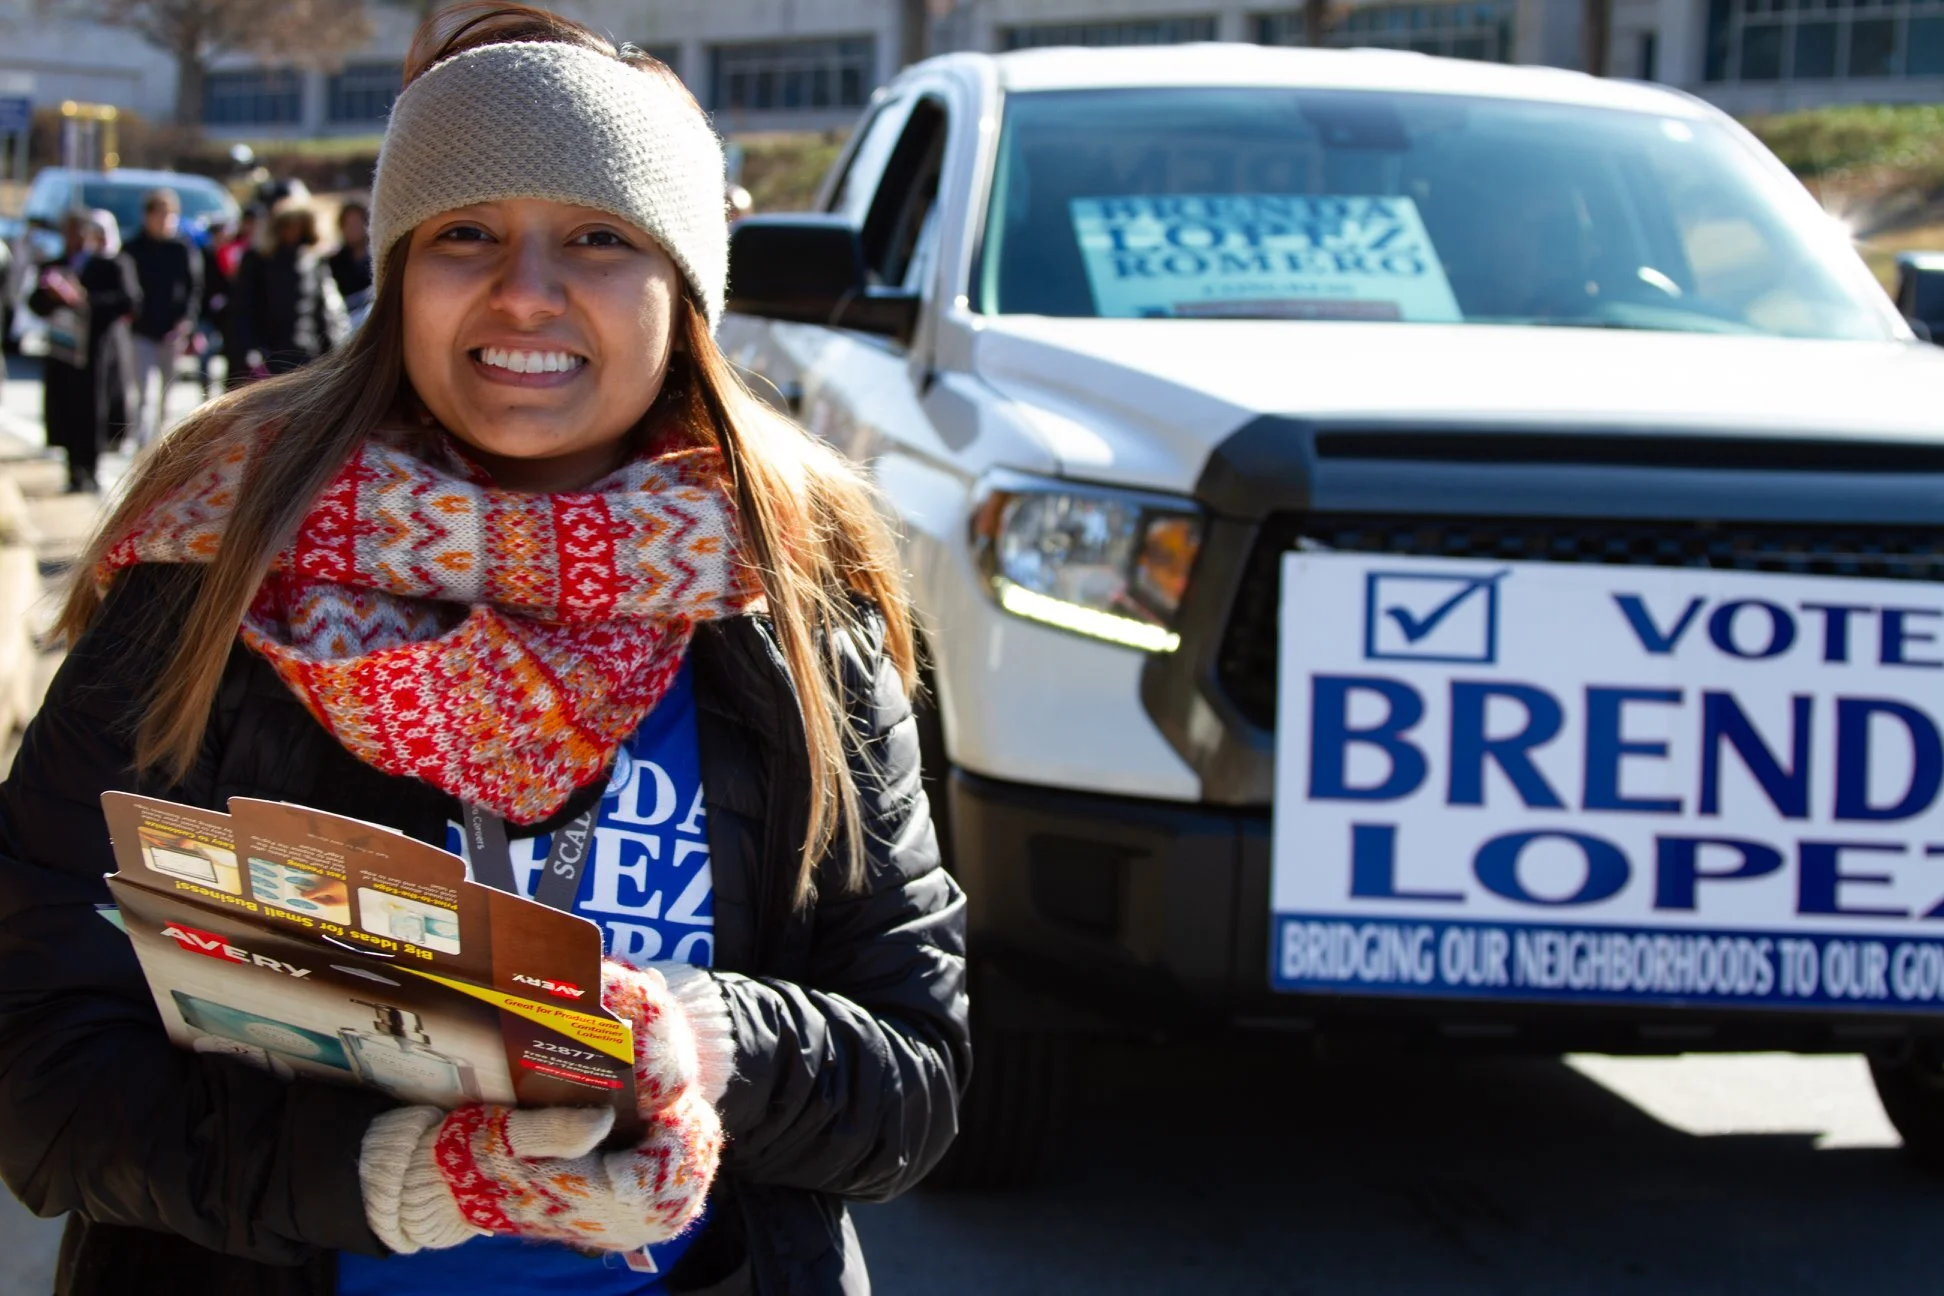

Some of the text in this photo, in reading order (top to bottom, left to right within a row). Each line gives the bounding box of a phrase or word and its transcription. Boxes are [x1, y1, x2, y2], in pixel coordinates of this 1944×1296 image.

[1108, 250, 1427, 279] ROMERO
[1609, 592, 1944, 668] VOTE
[1306, 673, 1944, 823] BREND
[175, 881, 434, 961] Big Ideas for Small Business!
[160, 927, 312, 979] AVERY
[1279, 920, 1435, 985] BRIDGING
[1439, 925, 1510, 988] OUR
[1513, 928, 1775, 996] NEIGHBORHOODS
[1777, 937, 1820, 998] TO
[1821, 939, 1889, 1000] OUR
[512, 974, 586, 997] AVERY
[504, 998, 620, 1030] Great for Product and
[571, 1022, 624, 1037] Container
[576, 1030, 624, 1044] Labeling
